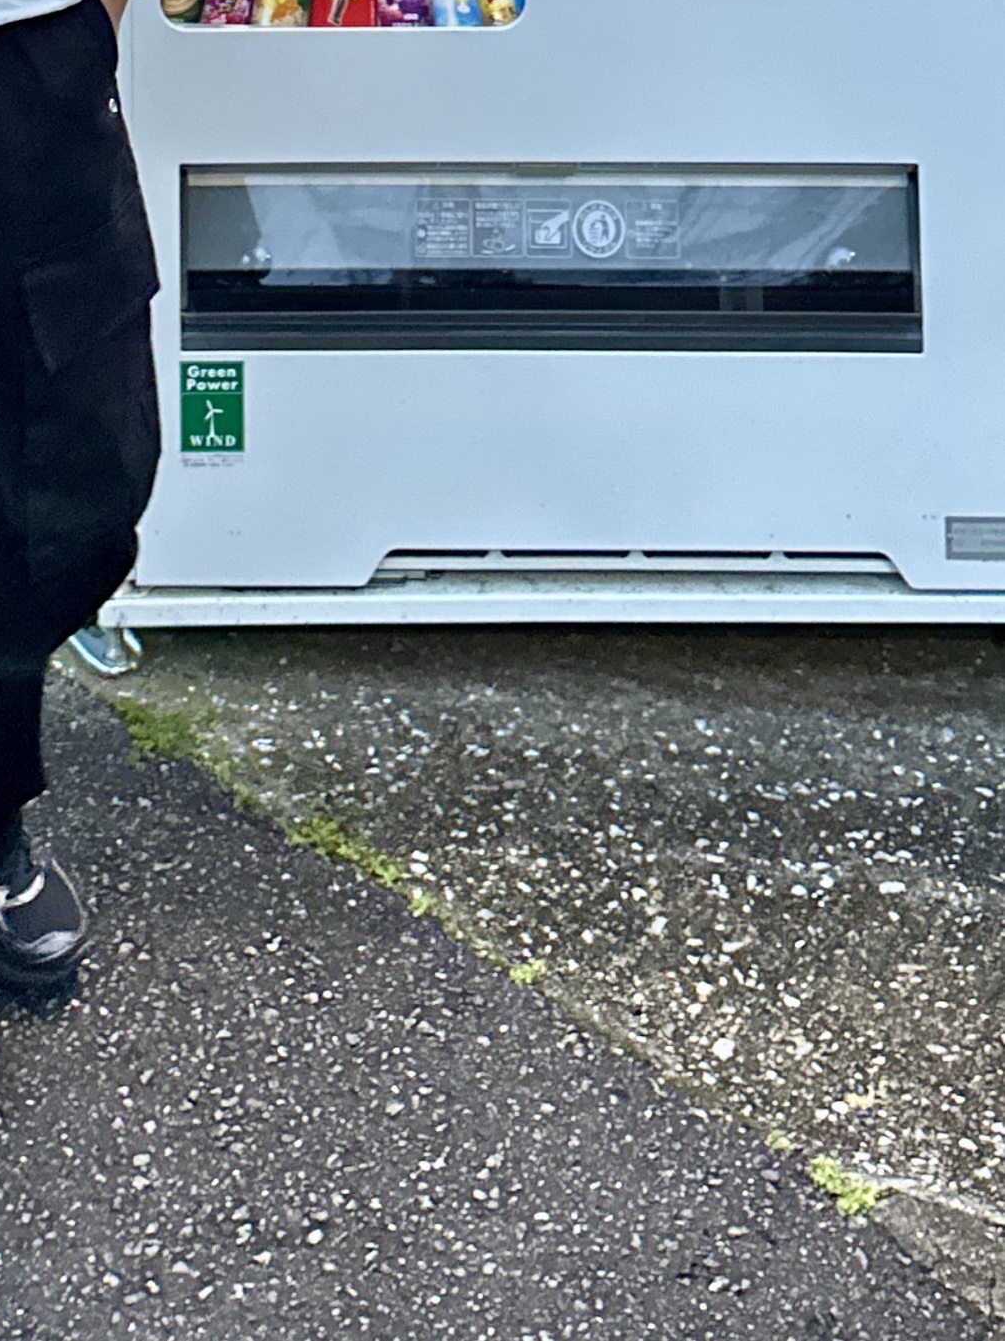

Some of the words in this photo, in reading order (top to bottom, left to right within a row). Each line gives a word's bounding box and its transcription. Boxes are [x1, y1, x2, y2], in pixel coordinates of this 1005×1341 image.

[186, 365, 237, 378] Green
[186, 378, 239, 391] Power
[189, 434, 237, 447] WIND
